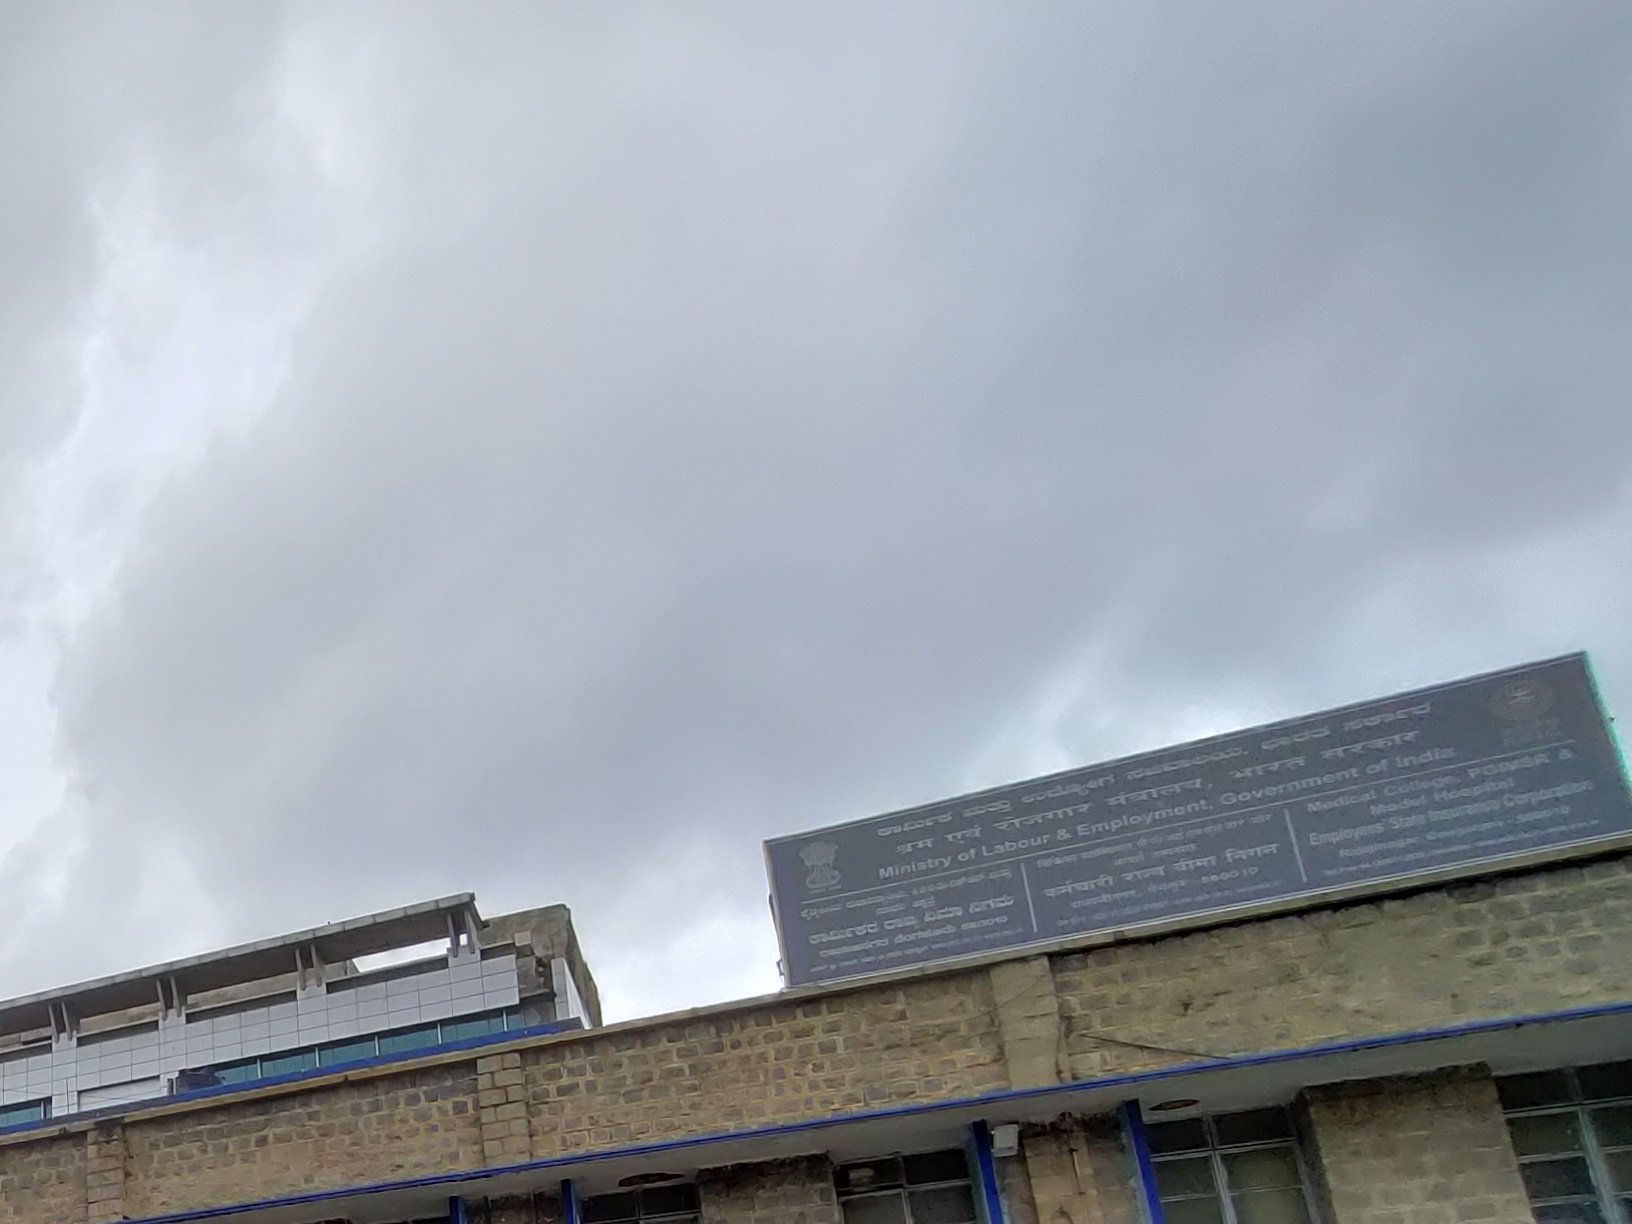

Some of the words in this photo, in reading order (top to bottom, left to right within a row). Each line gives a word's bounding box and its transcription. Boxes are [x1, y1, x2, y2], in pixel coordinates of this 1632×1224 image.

[895, 838, 934, 854] श्रम
[944, 825, 982, 845] एवं
[993, 800, 1091, 832] रोजगार
[1230, 755, 1306, 781] भारत
[1322, 730, 1420, 761] सरकार
[1307, 790, 1375, 812] Medical
[1370, 796, 1425, 814] Model
[1434, 777, 1513, 803] Hospital
[879, 854, 953, 879] Ministry
[956, 848, 977, 862] of
[982, 833, 1050, 856] Labour
[1056, 828, 1072, 841] &
[1077, 798, 1213, 837] Employment,
[1221, 766, 1359, 805] Government
[1364, 759, 1391, 775] of
[1396, 745, 1456, 767] India
[1388, 812, 1425, 829] State
